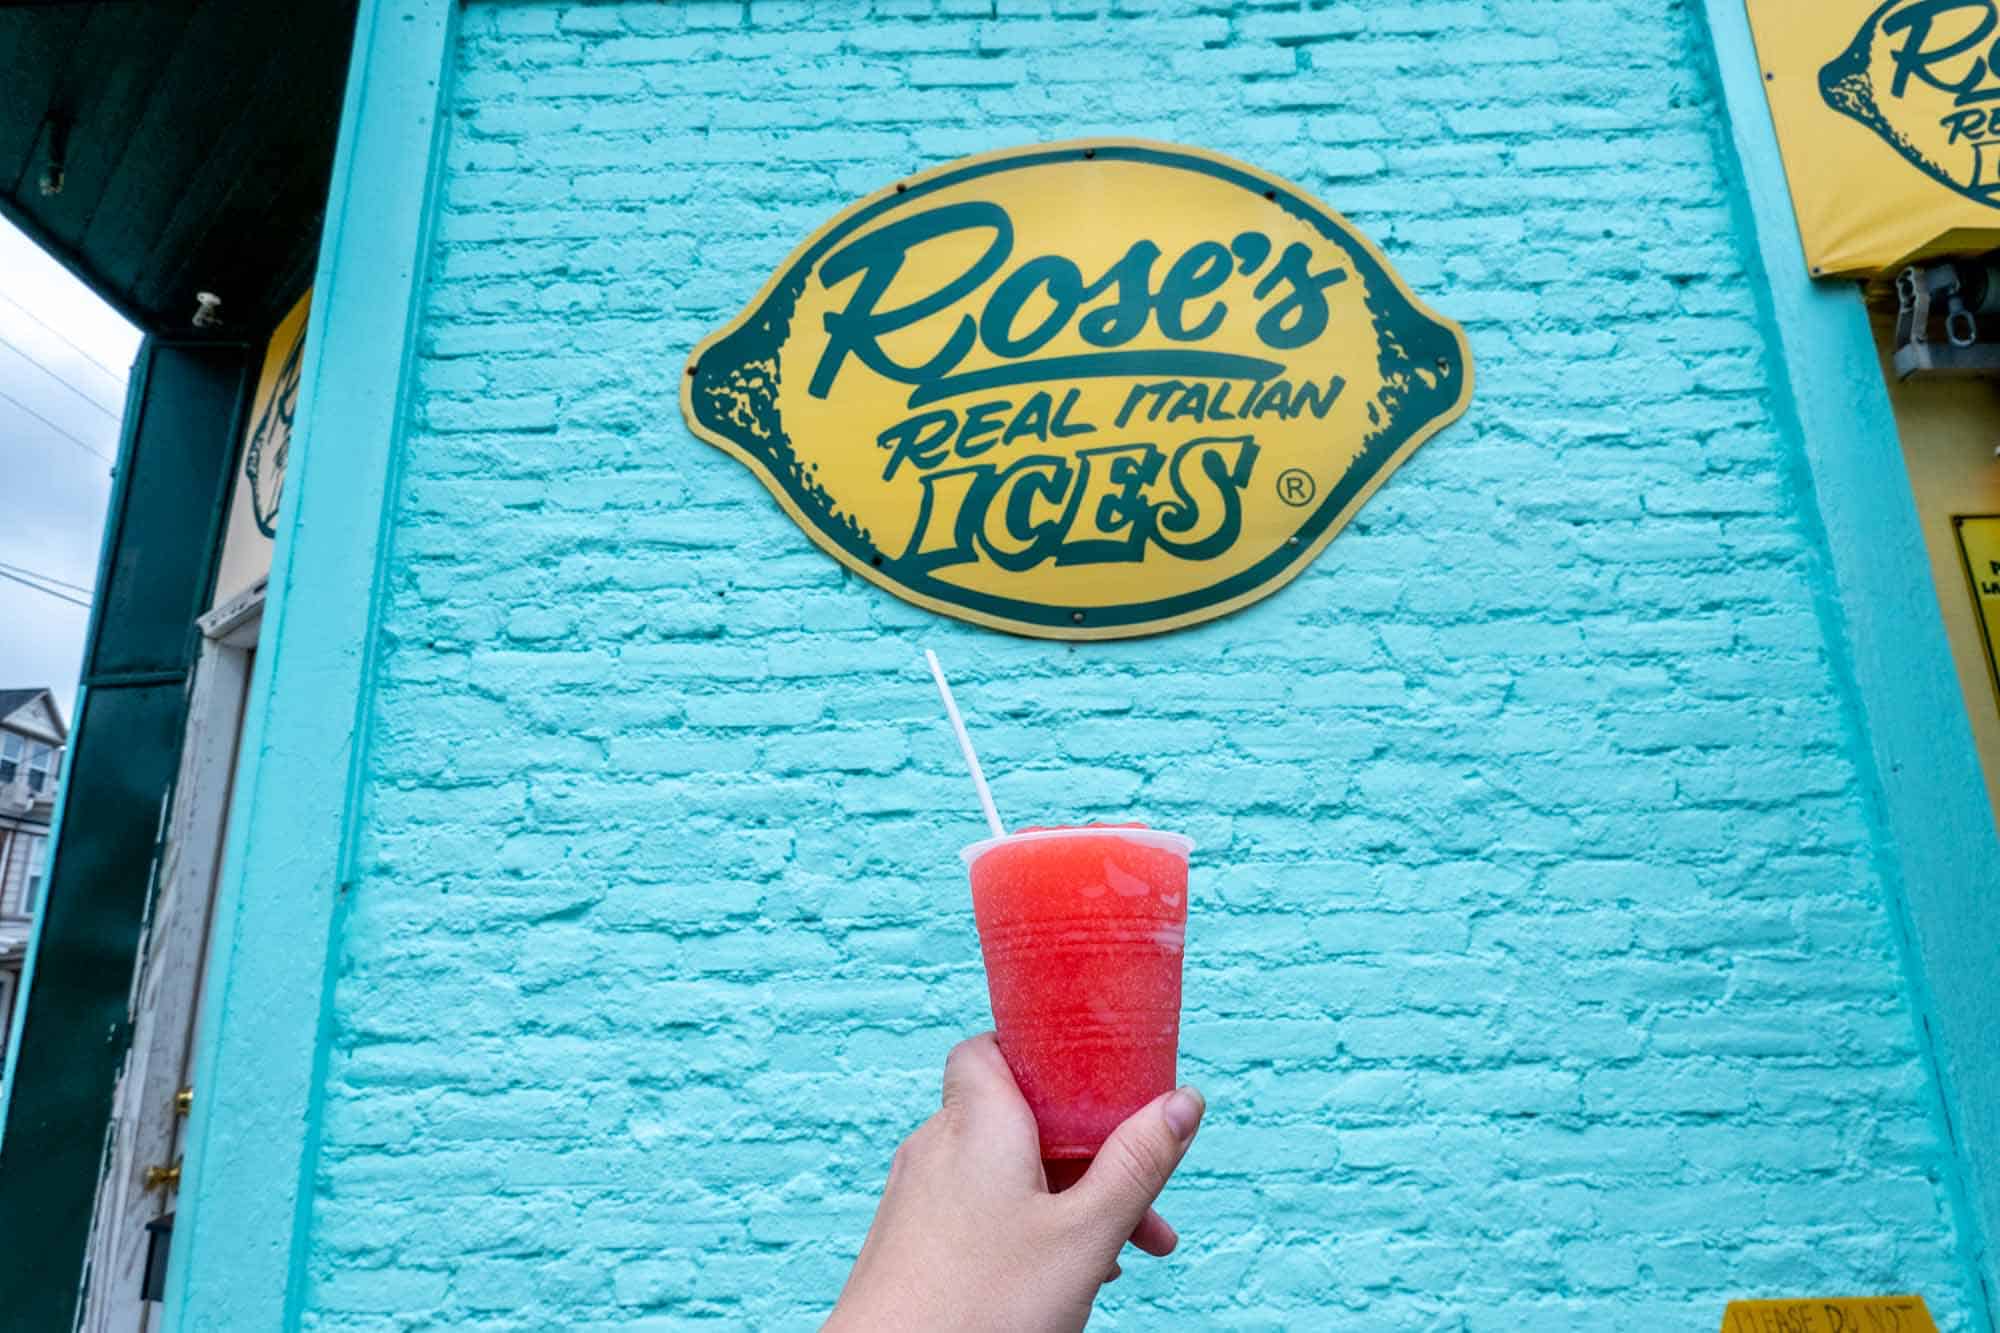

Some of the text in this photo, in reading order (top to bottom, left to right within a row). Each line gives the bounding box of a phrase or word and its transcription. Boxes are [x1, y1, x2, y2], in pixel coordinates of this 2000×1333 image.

[808, 201, 1347, 400] Rose's
[877, 375, 1346, 482] REAL ITALIAN
[900, 435, 1262, 570] ICES
